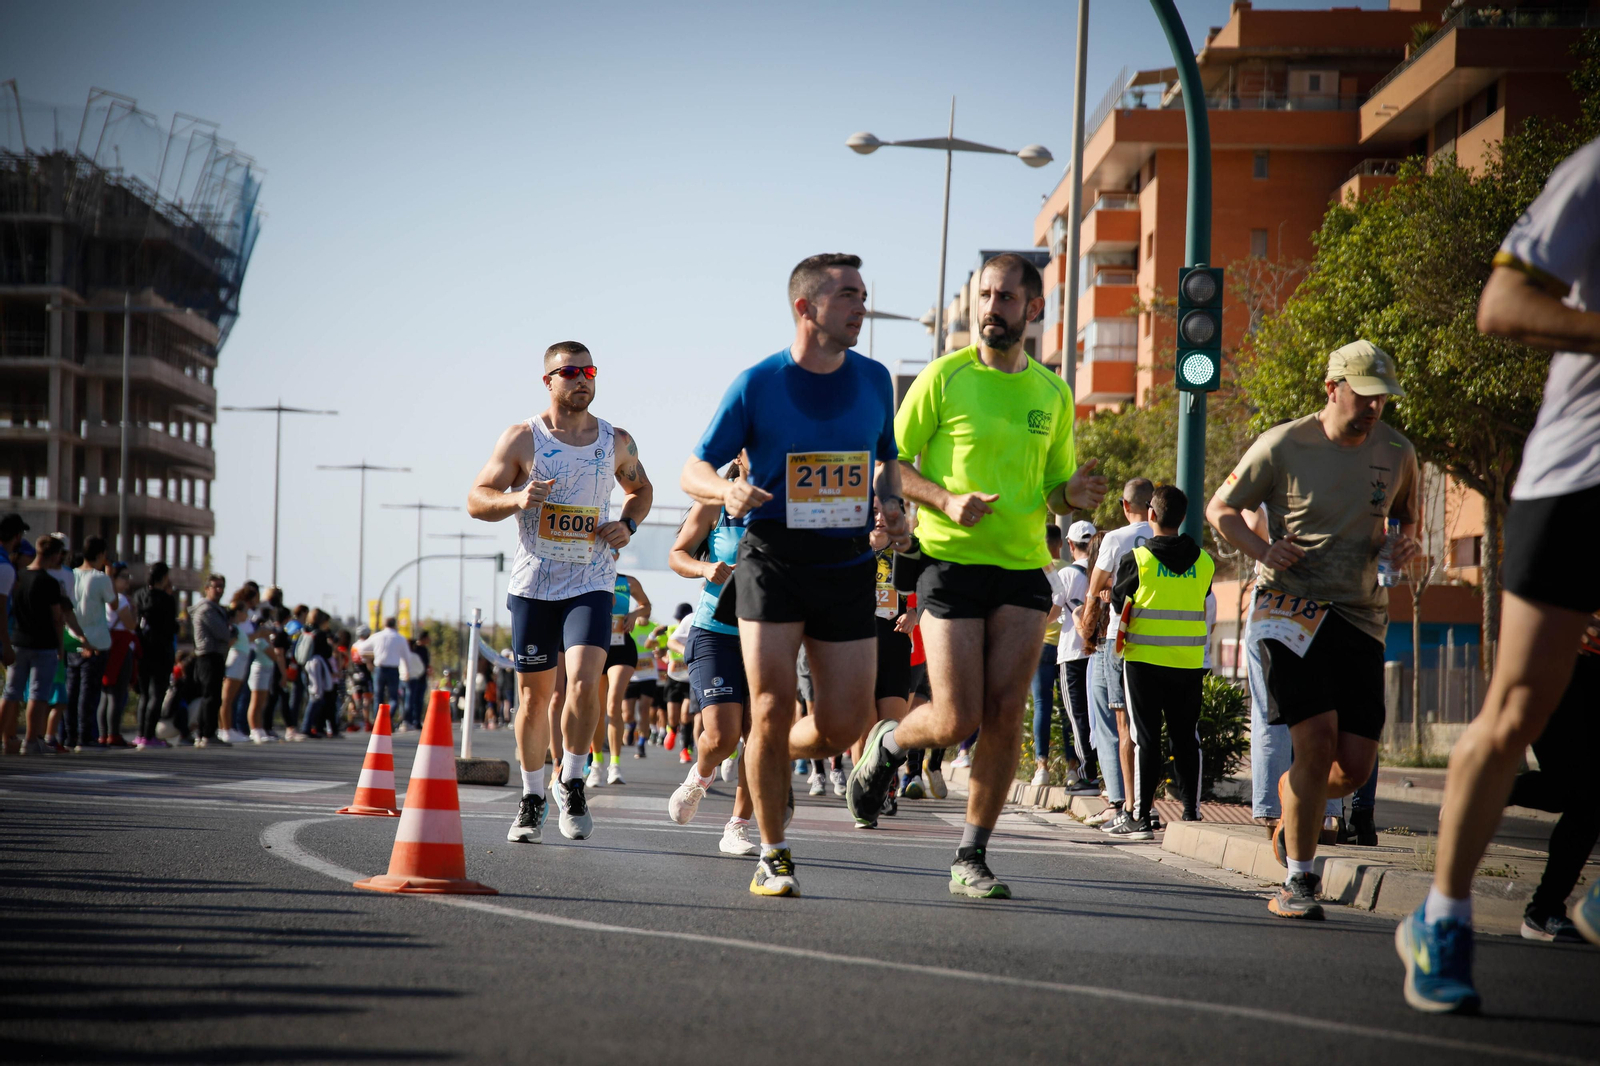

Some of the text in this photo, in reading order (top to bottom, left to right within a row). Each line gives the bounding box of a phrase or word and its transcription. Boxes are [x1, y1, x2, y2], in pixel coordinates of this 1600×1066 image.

[796, 464, 862, 487] 2115
[546, 512, 595, 533] 1608
[1257, 592, 1319, 620] 2118
[703, 686, 733, 697] FDC
